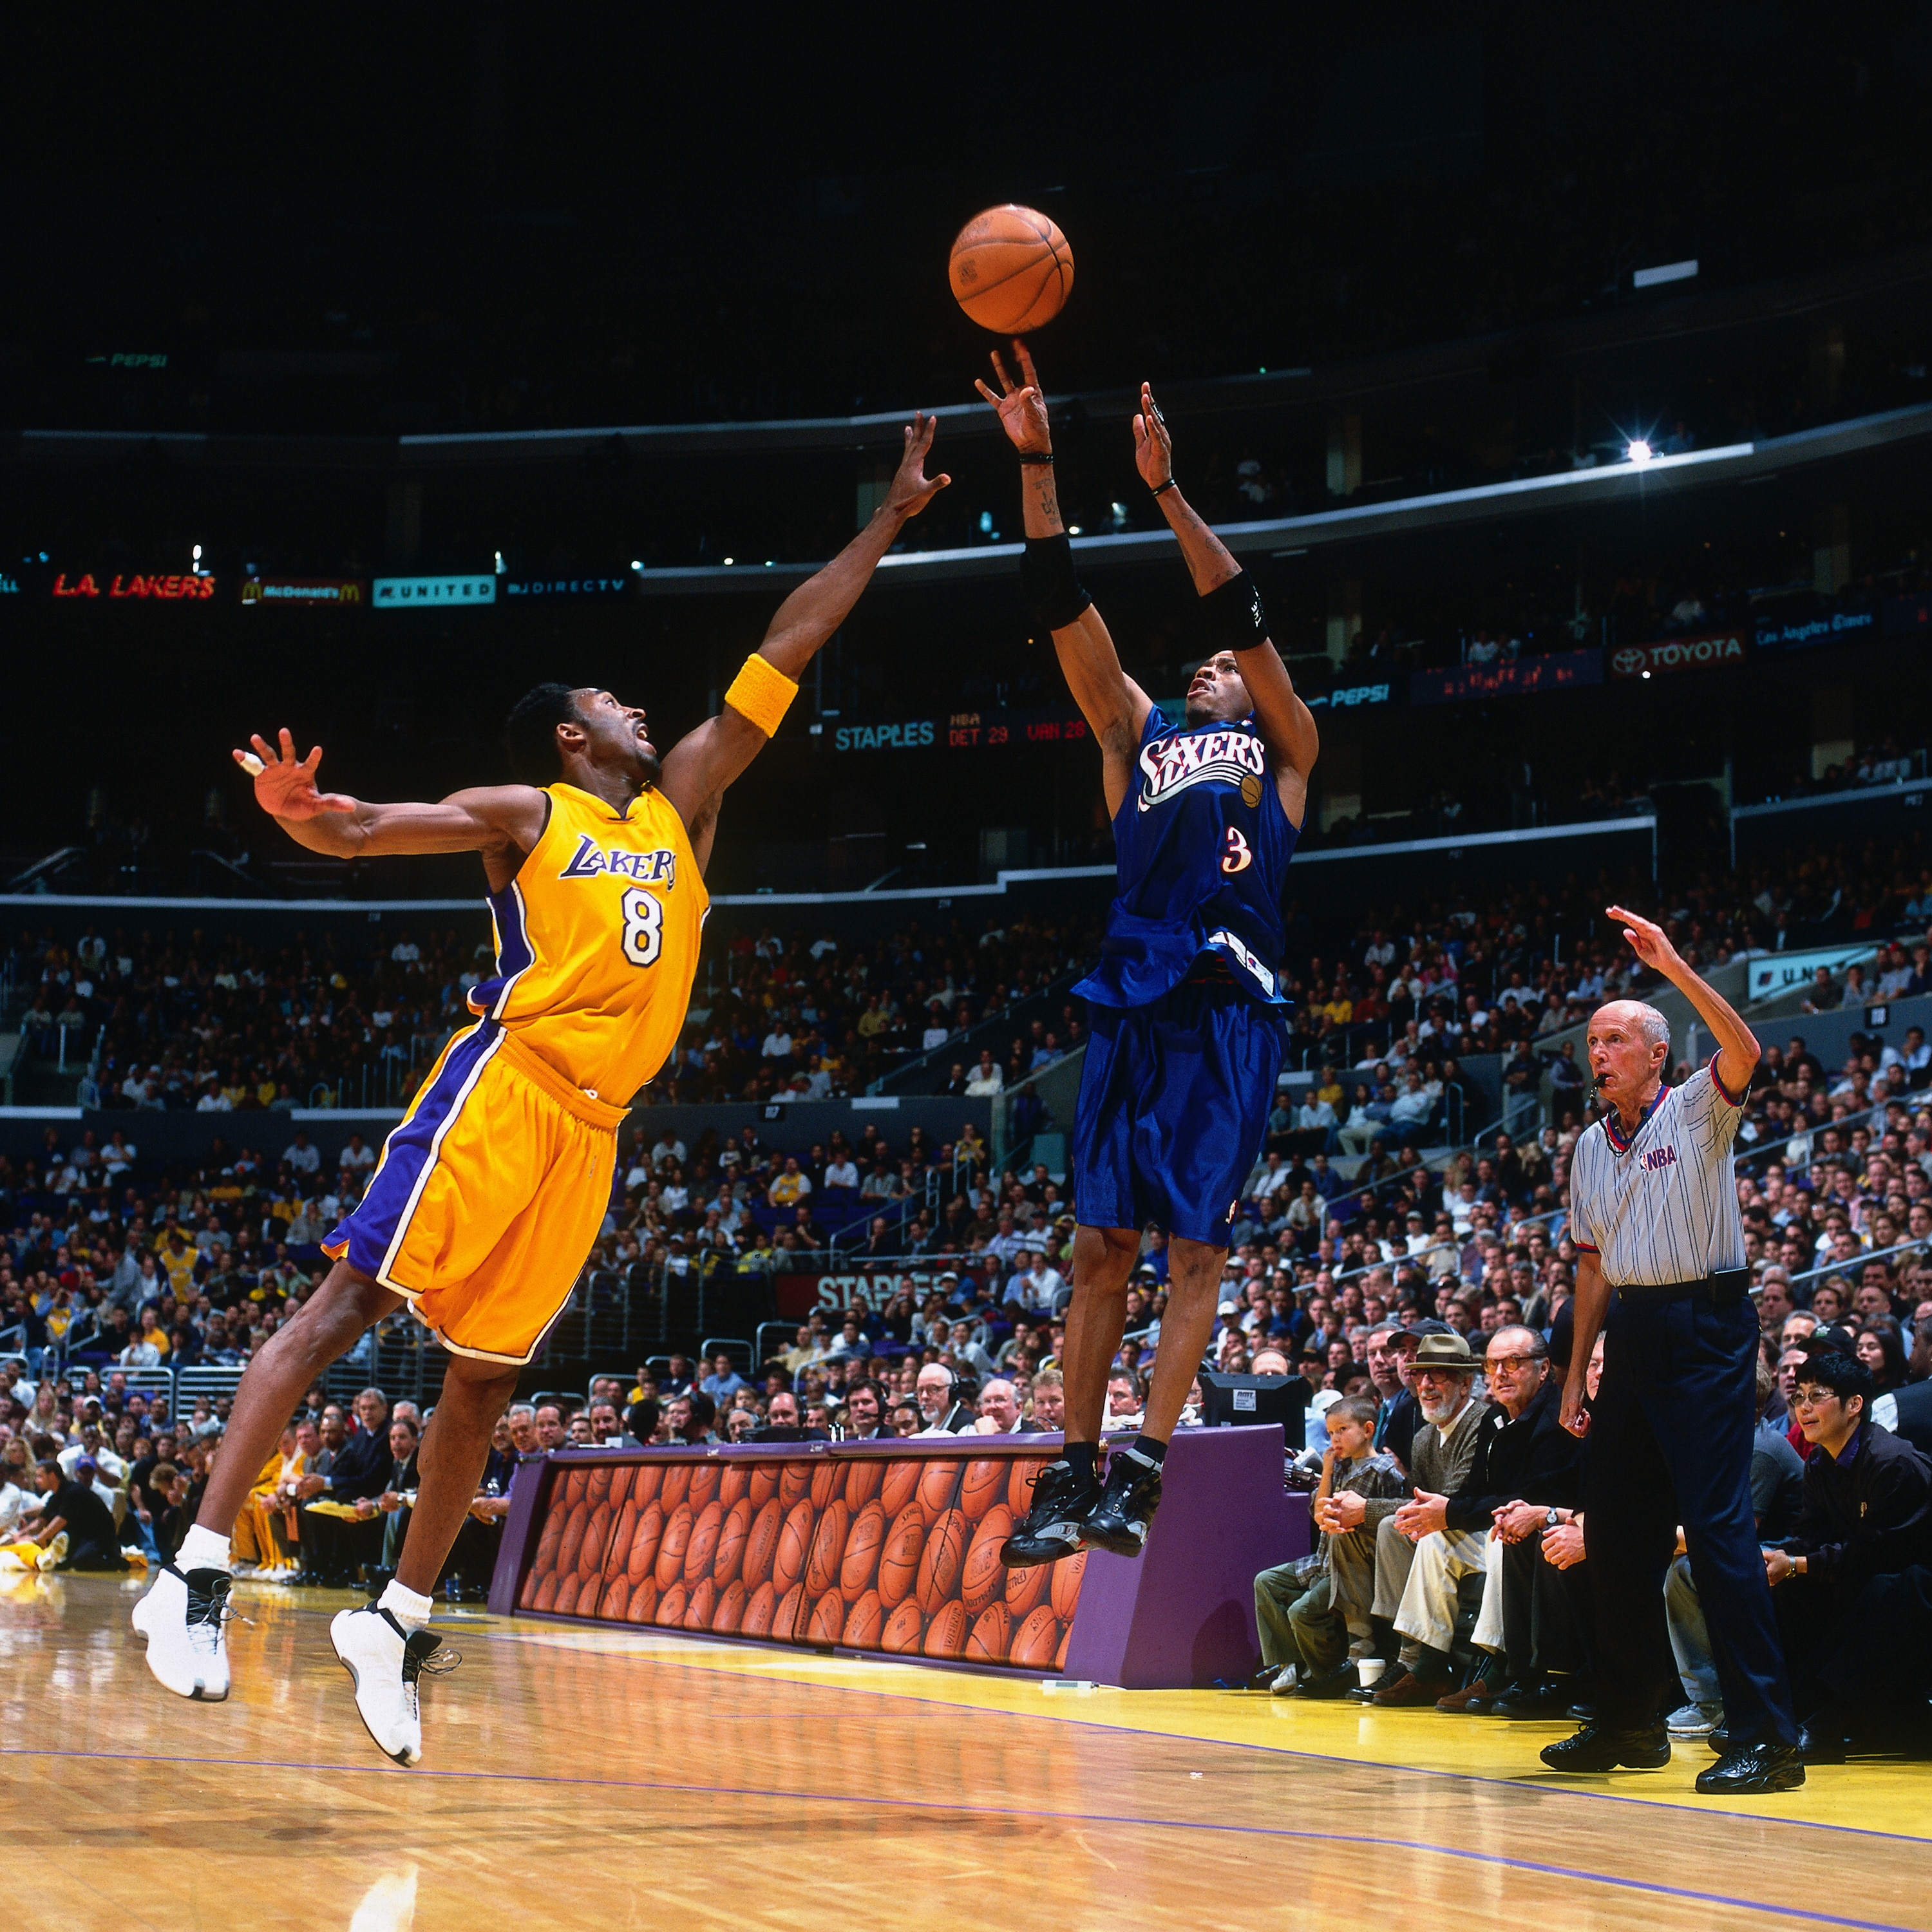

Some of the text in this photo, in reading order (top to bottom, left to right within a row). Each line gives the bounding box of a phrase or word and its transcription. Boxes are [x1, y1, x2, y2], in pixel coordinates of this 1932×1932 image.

[110, 354, 168, 368] PEPSI
[109, 574, 215, 600] LAKERS
[400, 583, 490, 598] UNITED
[532, 579, 625, 594] DIRECTV
[1649, 638, 1742, 666] TOYOTA
[1331, 683, 1390, 708] PEPSI
[836, 722, 934, 751] STAPLES
[949, 728, 981, 747] DET
[1065, 719, 1086, 739] 28
[1221, 826, 1252, 873] 3
[621, 887, 663, 968] 8
[1647, 1145, 1677, 1171] NBA
[817, 1273, 945, 1312] STAPE
